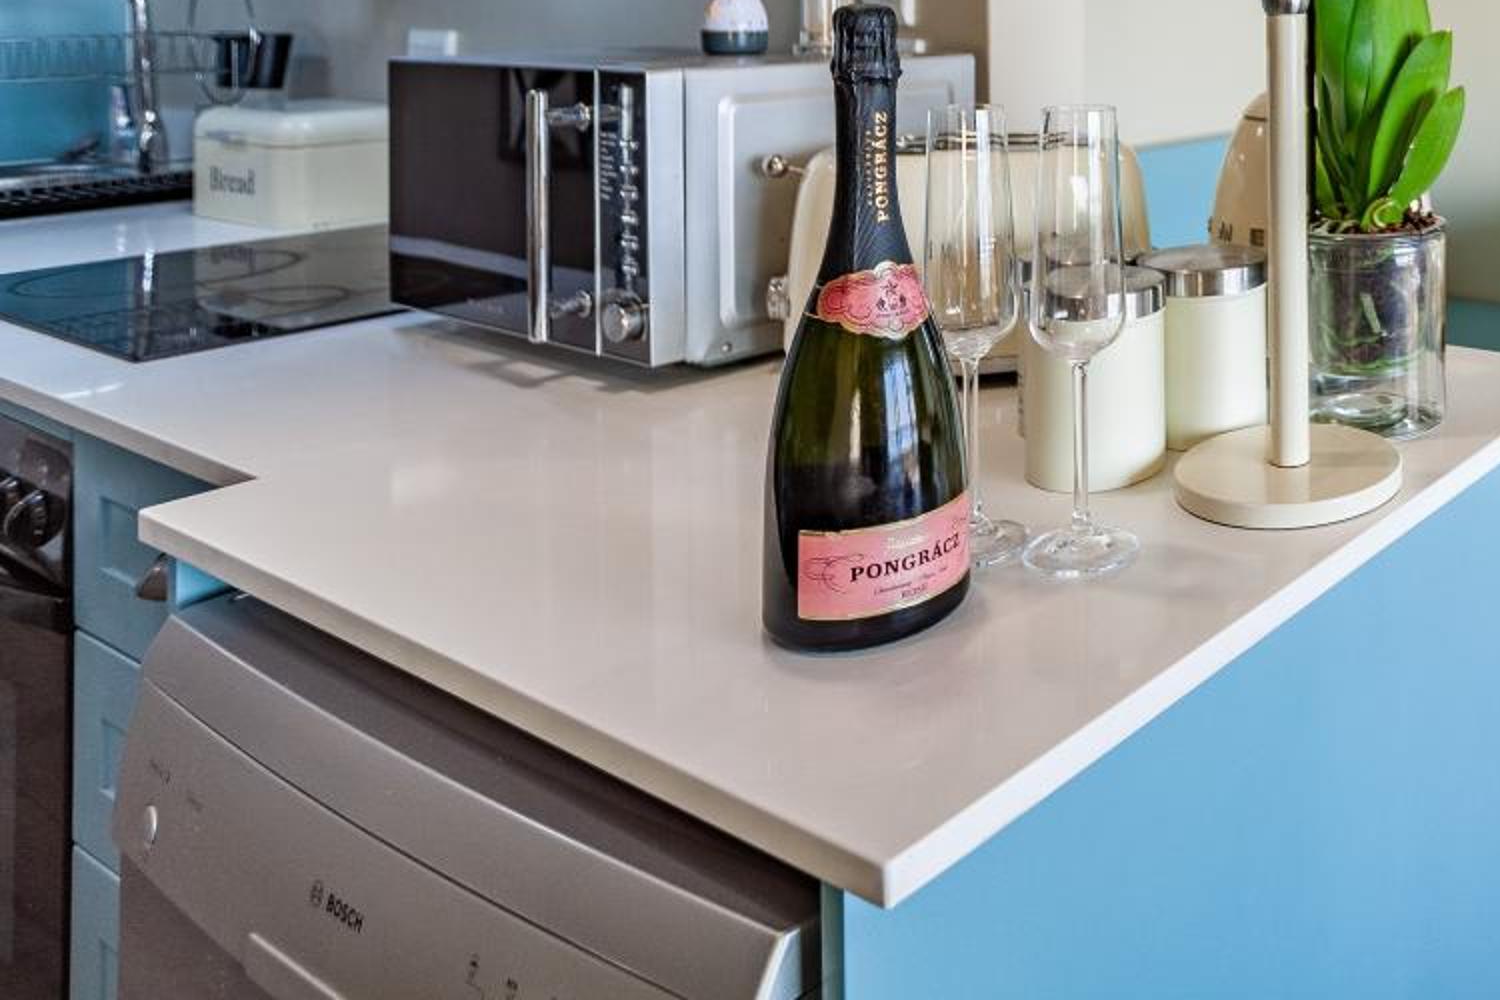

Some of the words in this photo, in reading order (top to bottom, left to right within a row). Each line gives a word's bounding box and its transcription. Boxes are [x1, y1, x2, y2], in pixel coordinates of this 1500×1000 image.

[209, 166, 256, 196] Bread
[872, 111, 890, 223] PONGRÁCZ
[850, 532, 961, 583] PONGRÁCZ
[326, 894, 364, 934] BOSCH
